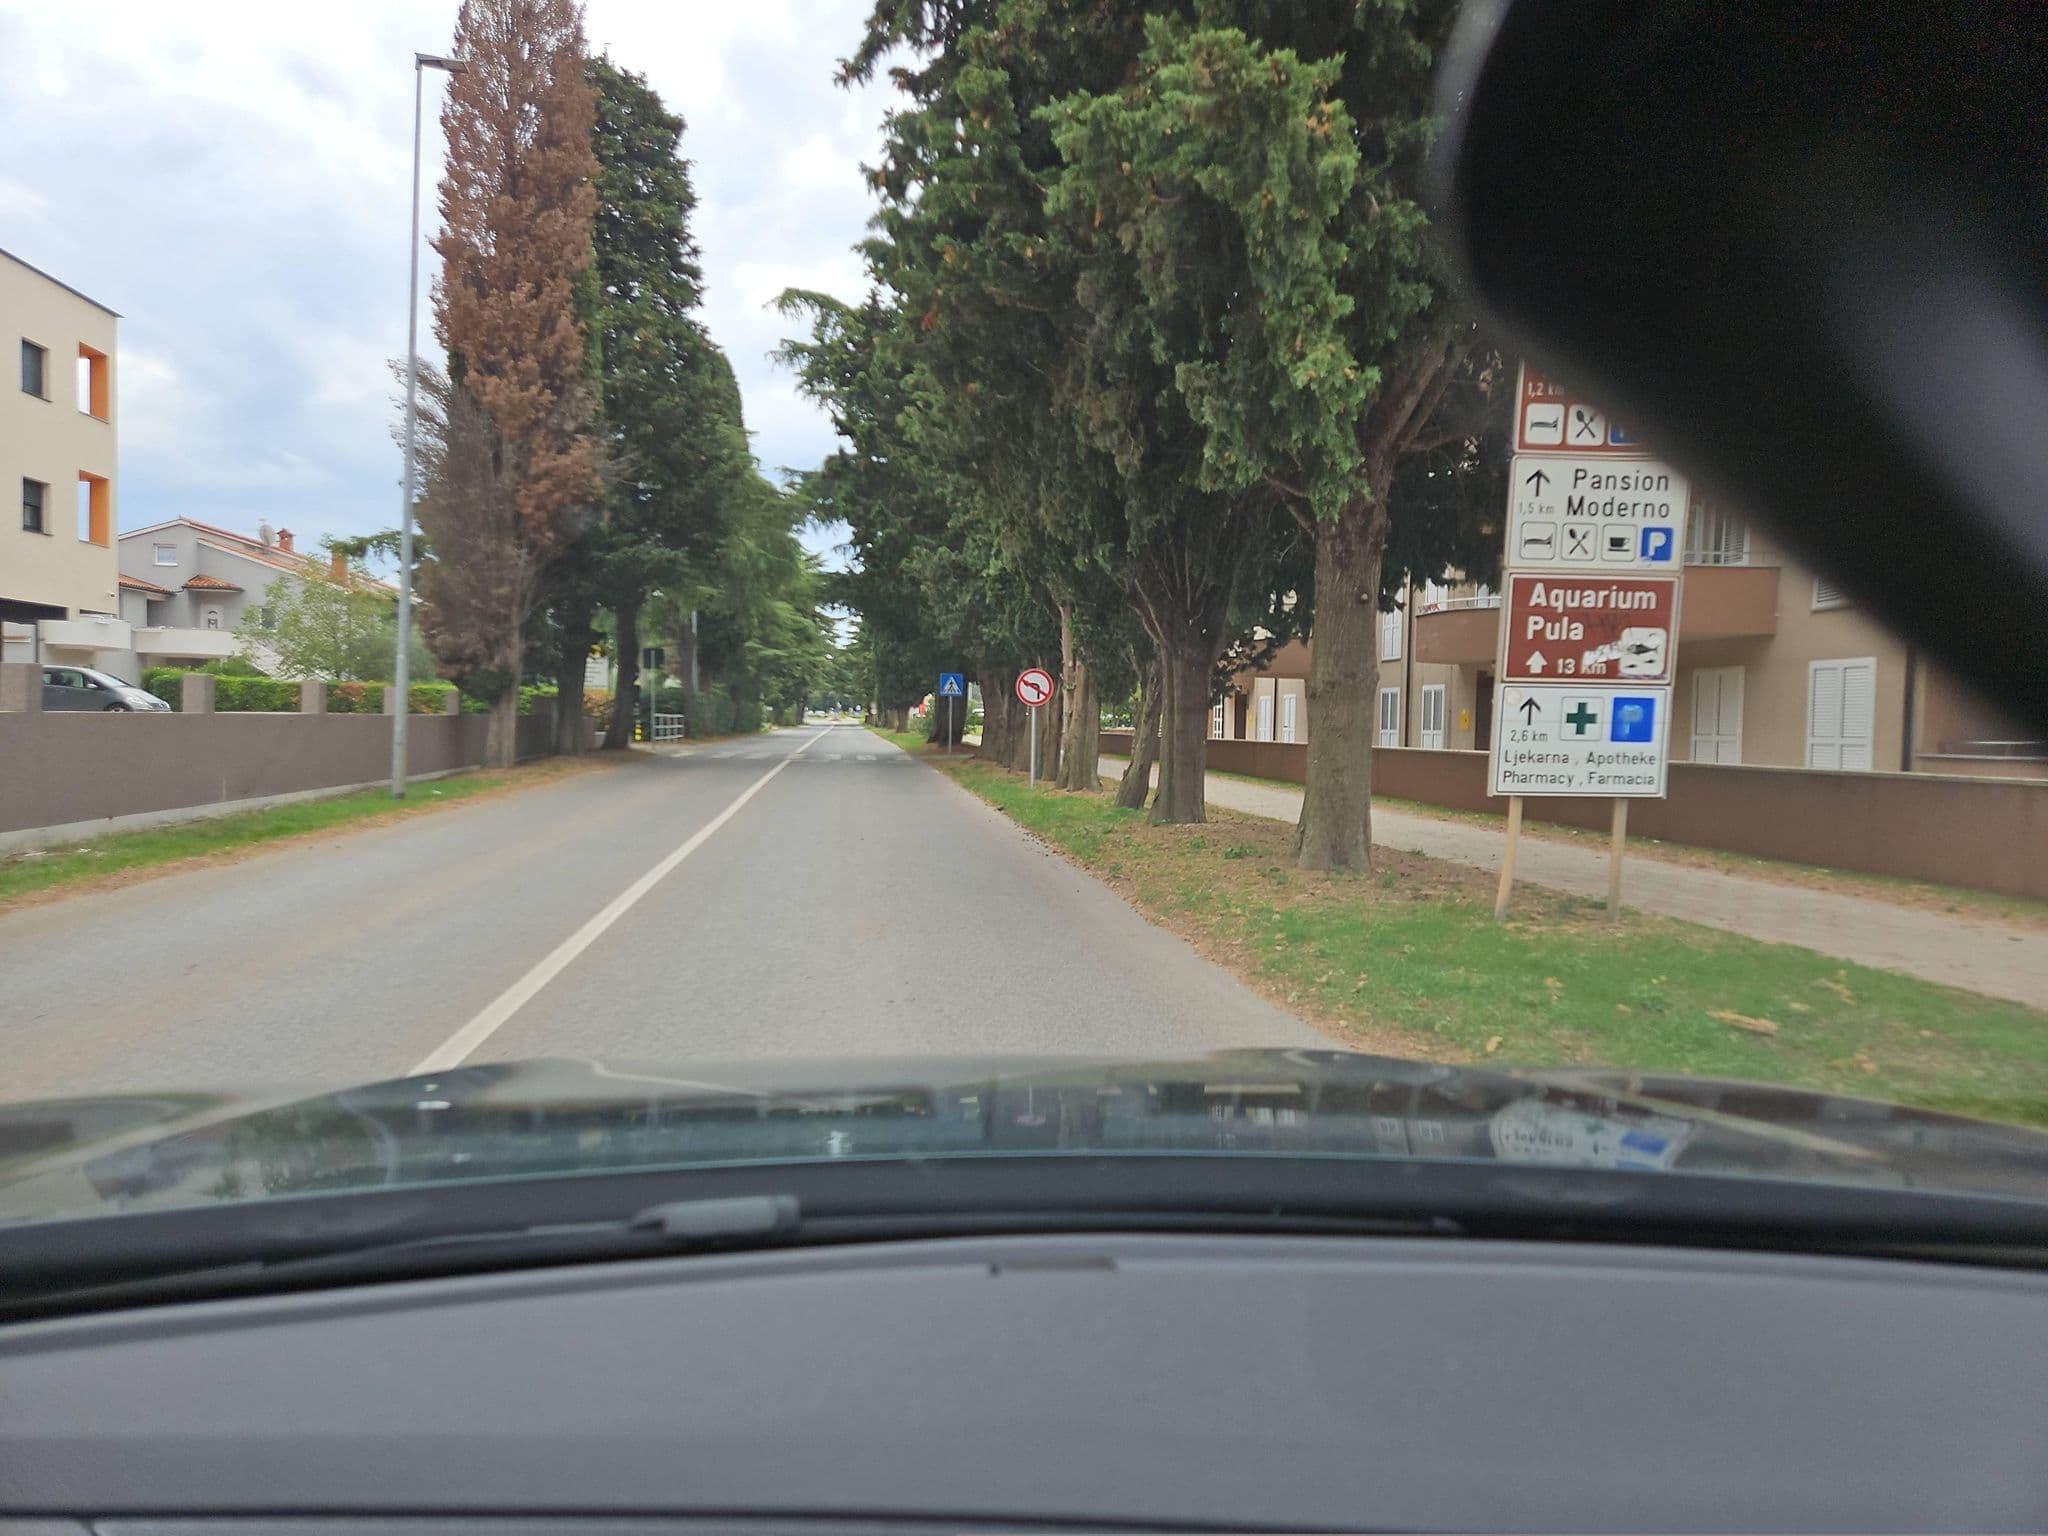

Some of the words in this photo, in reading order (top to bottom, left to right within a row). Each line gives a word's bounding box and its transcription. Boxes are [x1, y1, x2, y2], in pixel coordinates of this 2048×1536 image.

[1573, 468, 1670, 491] Pansion
[1566, 495, 1671, 519] Moderno
[1528, 582, 1658, 613] Aquarium
[1526, 615, 1585, 641] Pula
[1557, 658, 1576, 674] 13
[1510, 729, 1528, 744] 2,6
[1532, 729, 1549, 743] km
[1504, 749, 1570, 766] Ljekarna
[1585, 751, 1657, 768] Apotheke
[1502, 770, 1576, 787] Pharmacy
[1588, 771, 1656, 785] Farmacia
